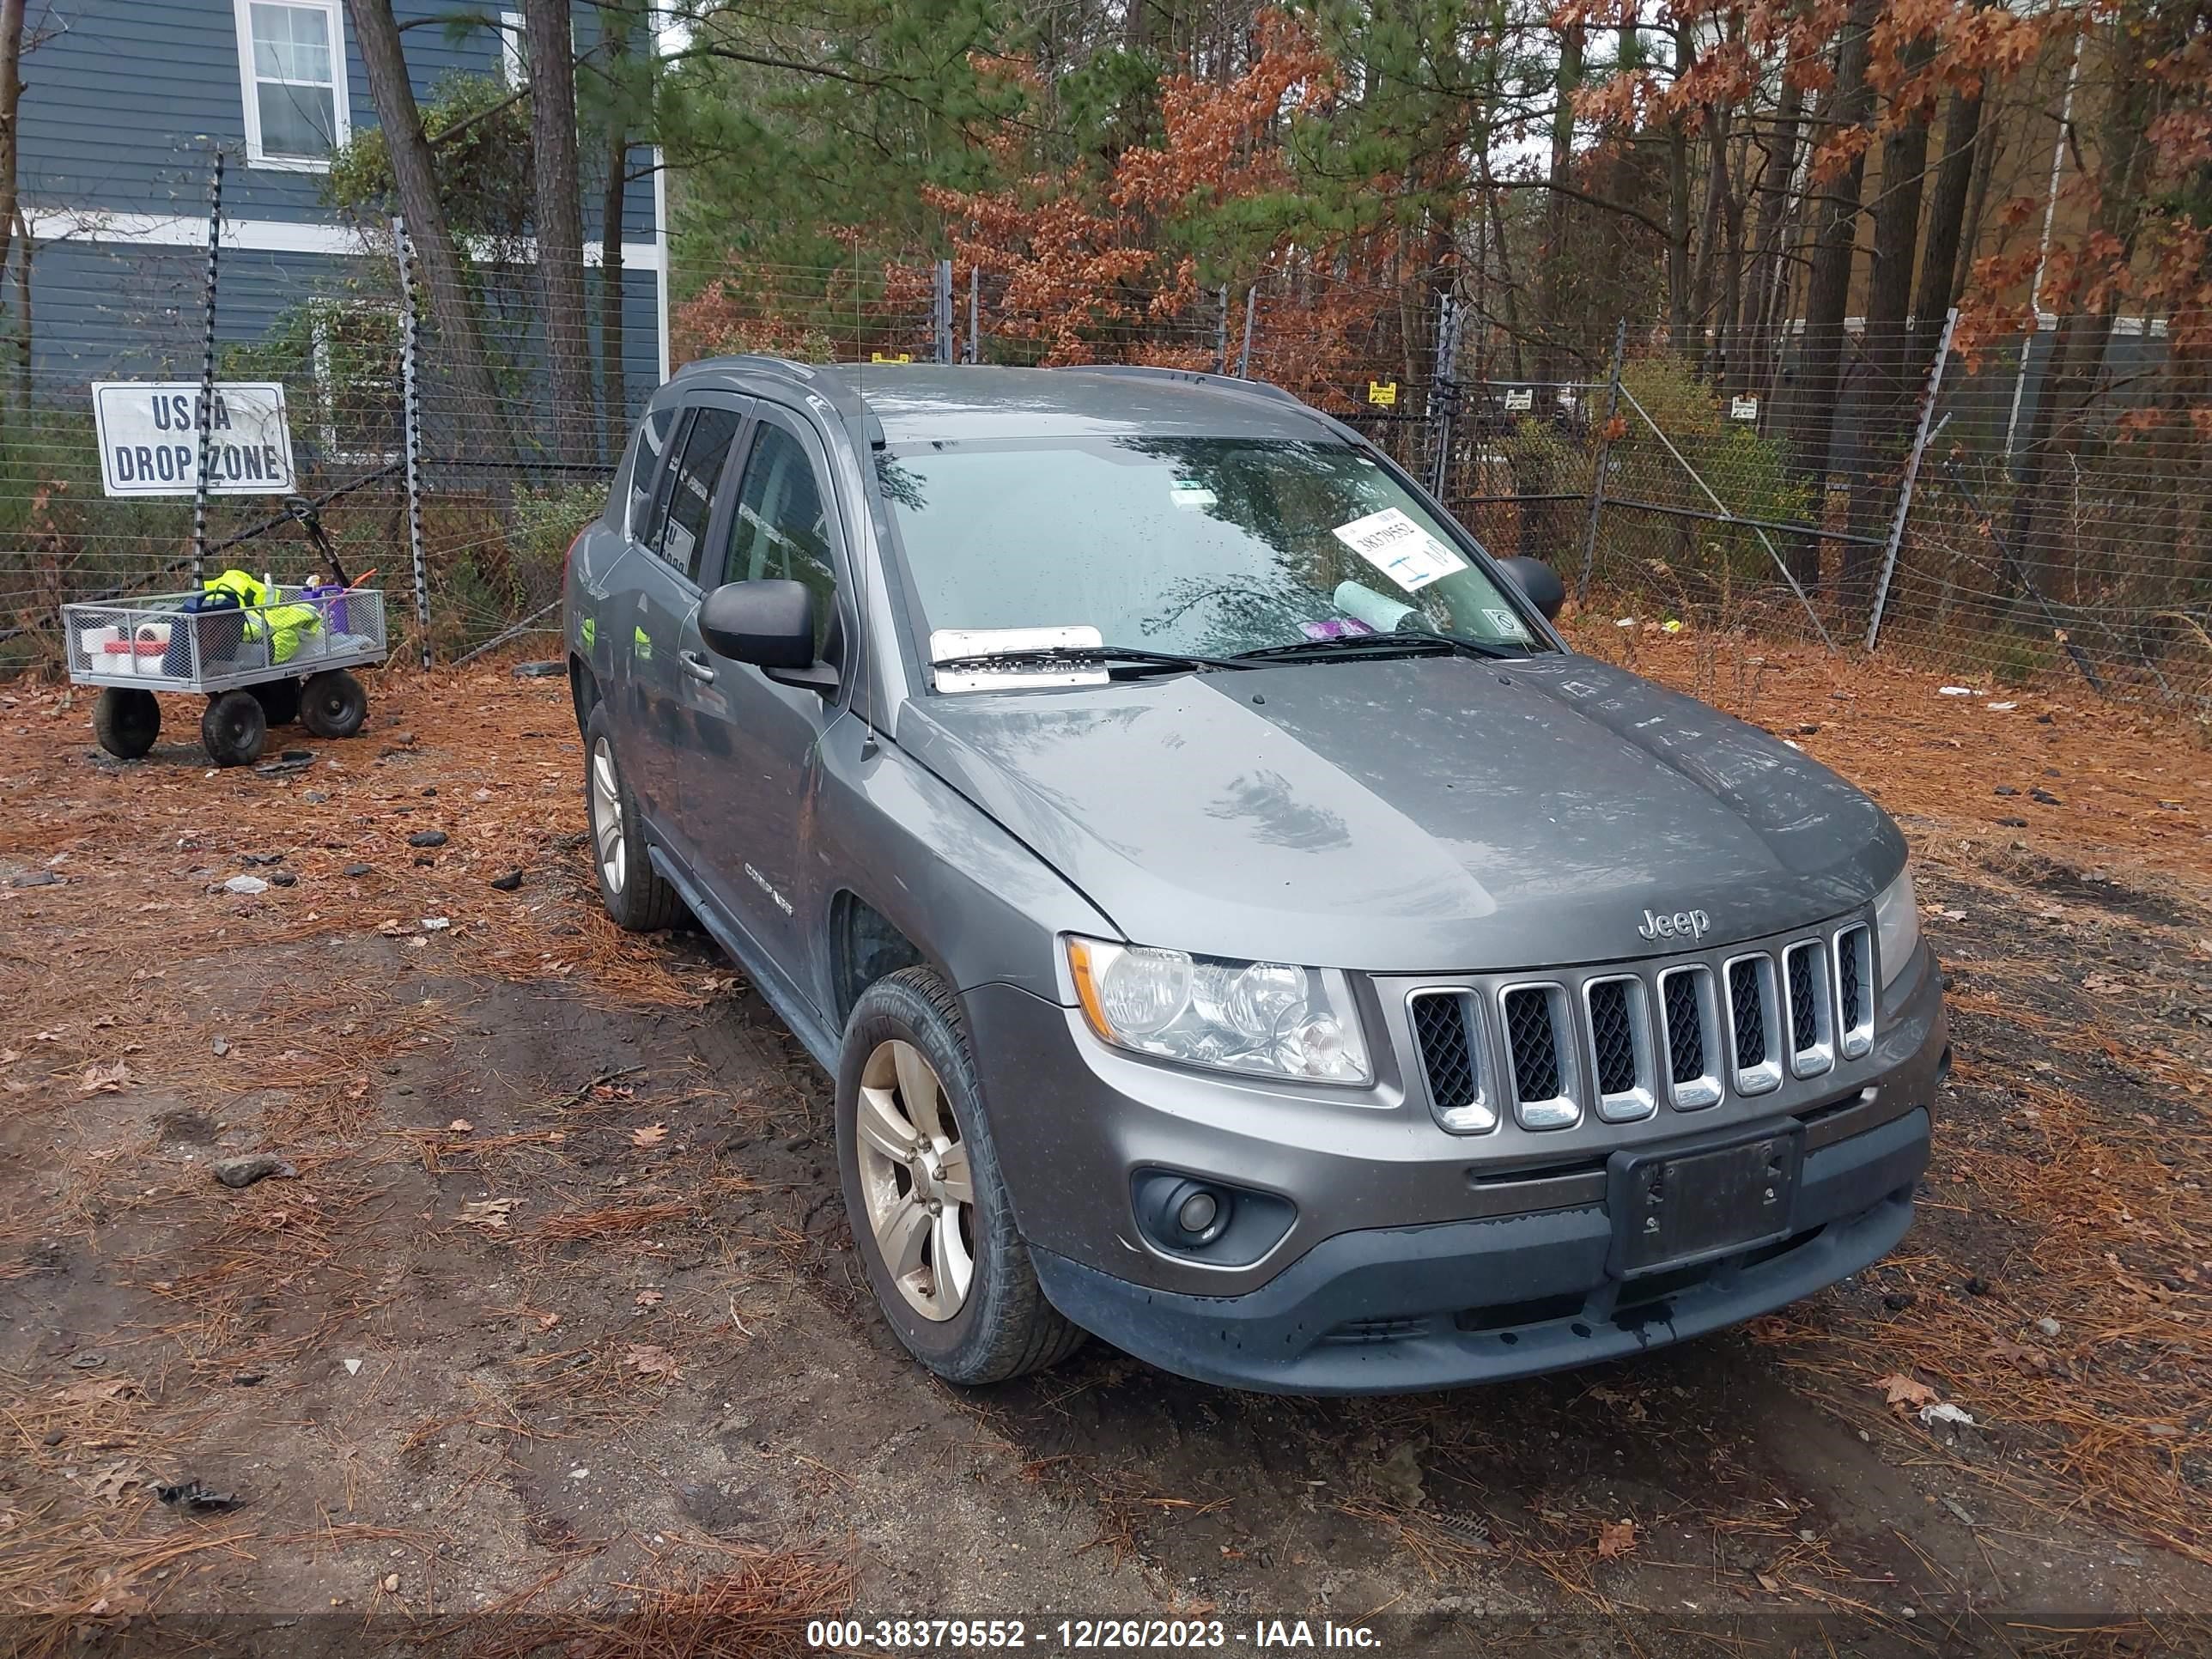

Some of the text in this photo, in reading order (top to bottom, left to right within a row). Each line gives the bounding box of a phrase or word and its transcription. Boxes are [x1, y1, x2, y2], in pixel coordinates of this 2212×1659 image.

[115, 445, 280, 481] DROP ZONE
[1356, 522, 1416, 552] 38379552
[1638, 909, 1711, 940] Jeep
